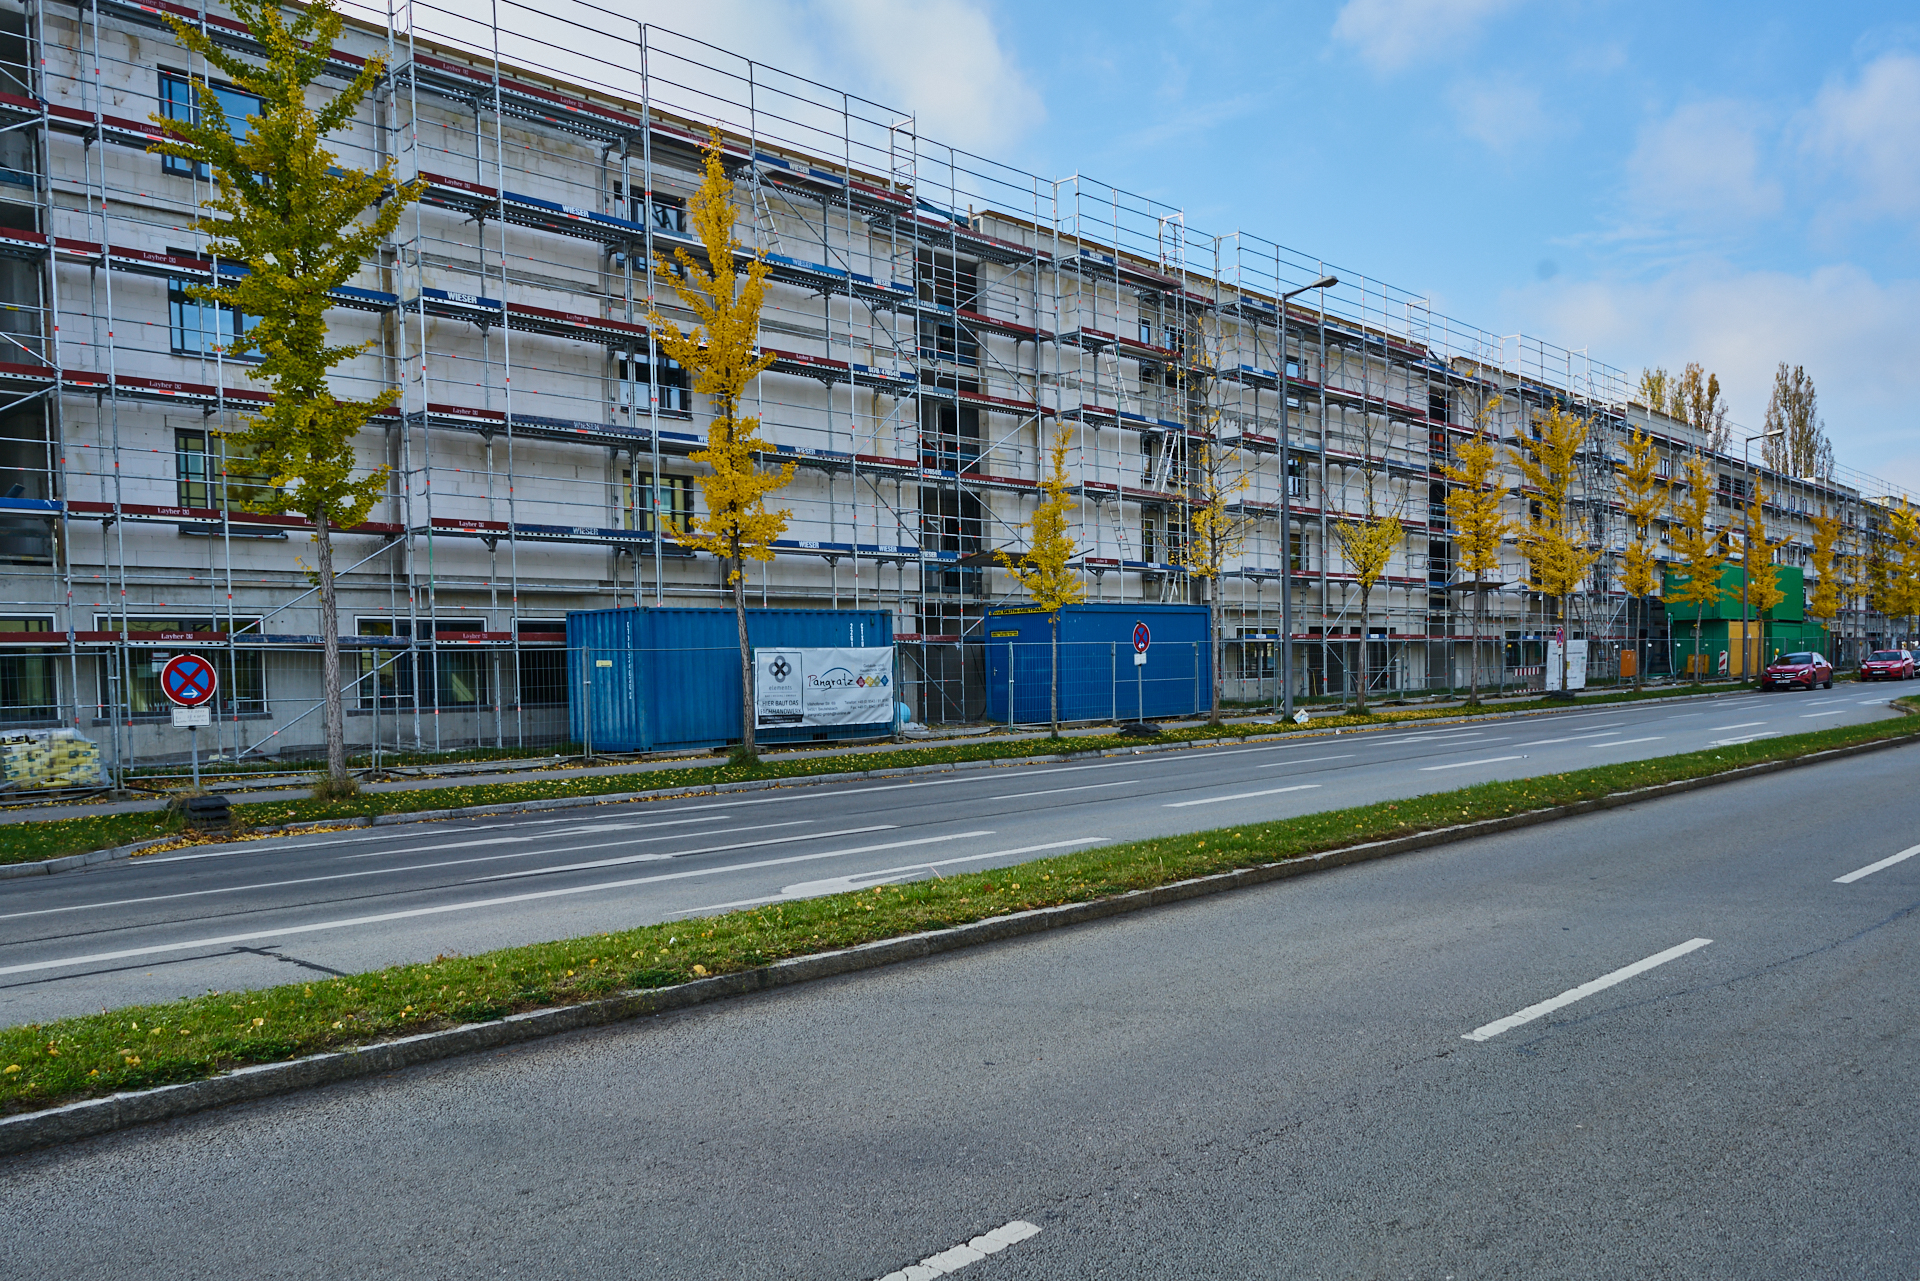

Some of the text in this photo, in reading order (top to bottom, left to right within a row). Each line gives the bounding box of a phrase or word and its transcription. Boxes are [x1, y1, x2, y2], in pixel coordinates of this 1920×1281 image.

[140, 124, 164, 134] Layher
[788, 162, 810, 175] WIESER
[444, 177, 463, 187] Layher
[562, 204, 590, 218] WIESER
[143, 252, 167, 262] Layher
[792, 258, 813, 269] WIESER
[873, 278, 892, 288] WIESER
[447, 291, 478, 304] WIESER
[149, 380, 173, 389] Layher
[452, 407, 472, 415] Layher
[574, 421, 600, 430] WIESER
[795, 446, 816, 455] WIESER
[157, 507, 181, 515] Layher
[459, 520, 477, 528] Layher
[573, 526, 599, 535] WIESER
[798, 541, 820, 549] WIESER
[879, 545, 898, 553] WIESER
[462, 632, 481, 640] Layher
[807, 673, 854, 691] Pangratz
